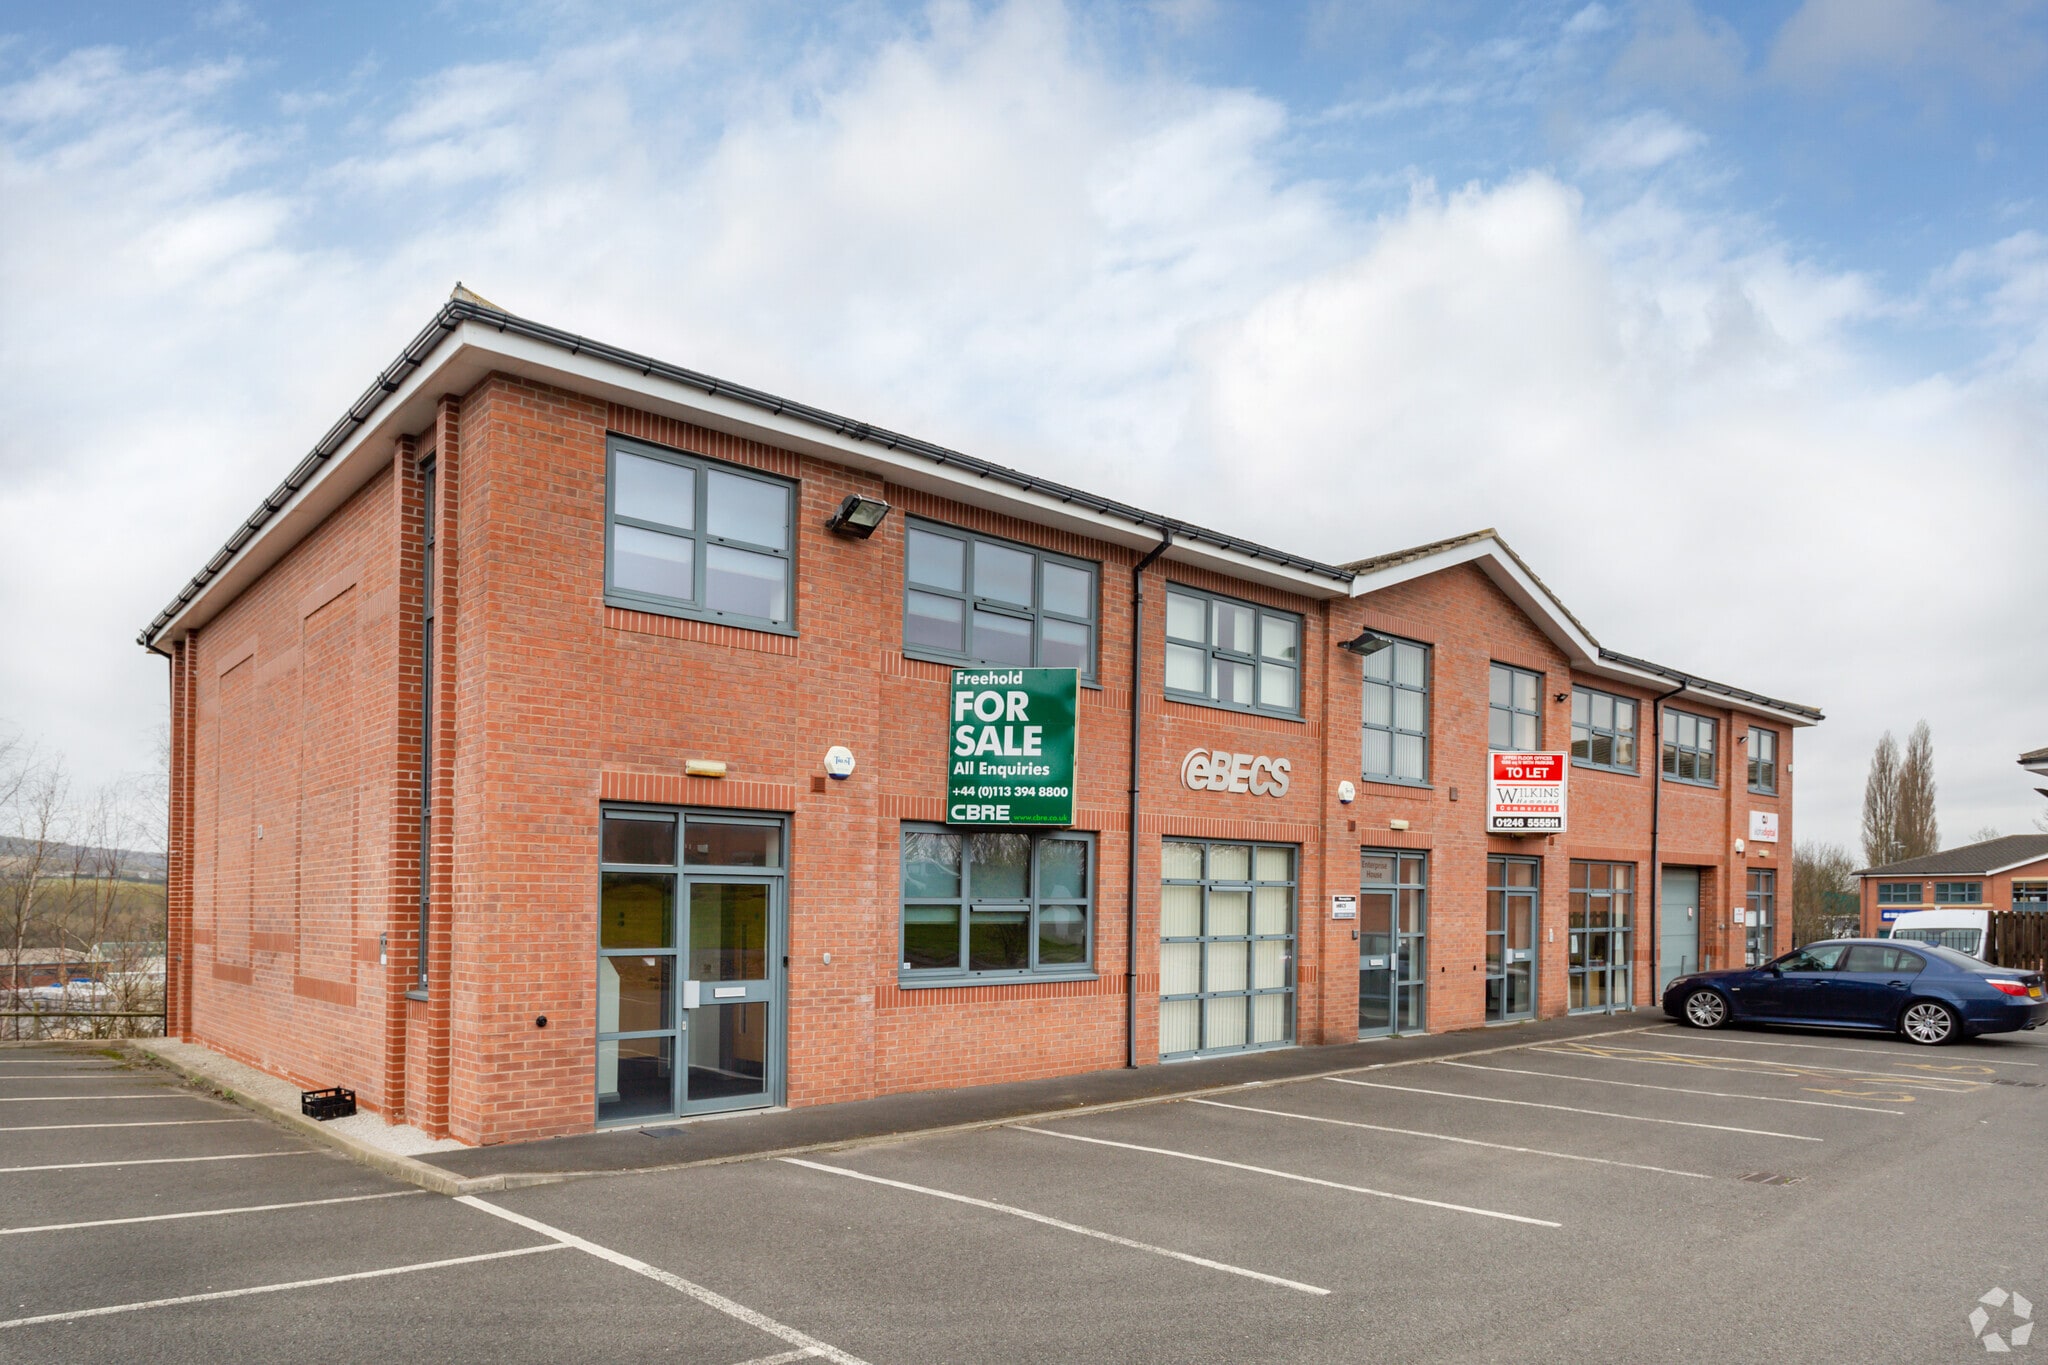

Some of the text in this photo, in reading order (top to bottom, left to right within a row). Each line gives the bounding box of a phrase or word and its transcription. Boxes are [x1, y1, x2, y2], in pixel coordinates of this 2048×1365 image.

[955, 671, 1023, 685] Freehold
[954, 690, 1030, 722] FOR
[954, 725, 1042, 757] SALE
[953, 761, 1050, 778] All Enquiries
[1506, 767, 1549, 778] TO LET
[952, 786, 1069, 799] +44 (0)113 394 8800
[1497, 788, 1559, 803] WILKINS
[951, 804, 1068, 822] CBRE www.cbre.co.uk
[1495, 818, 1559, 828] 01246 555511
